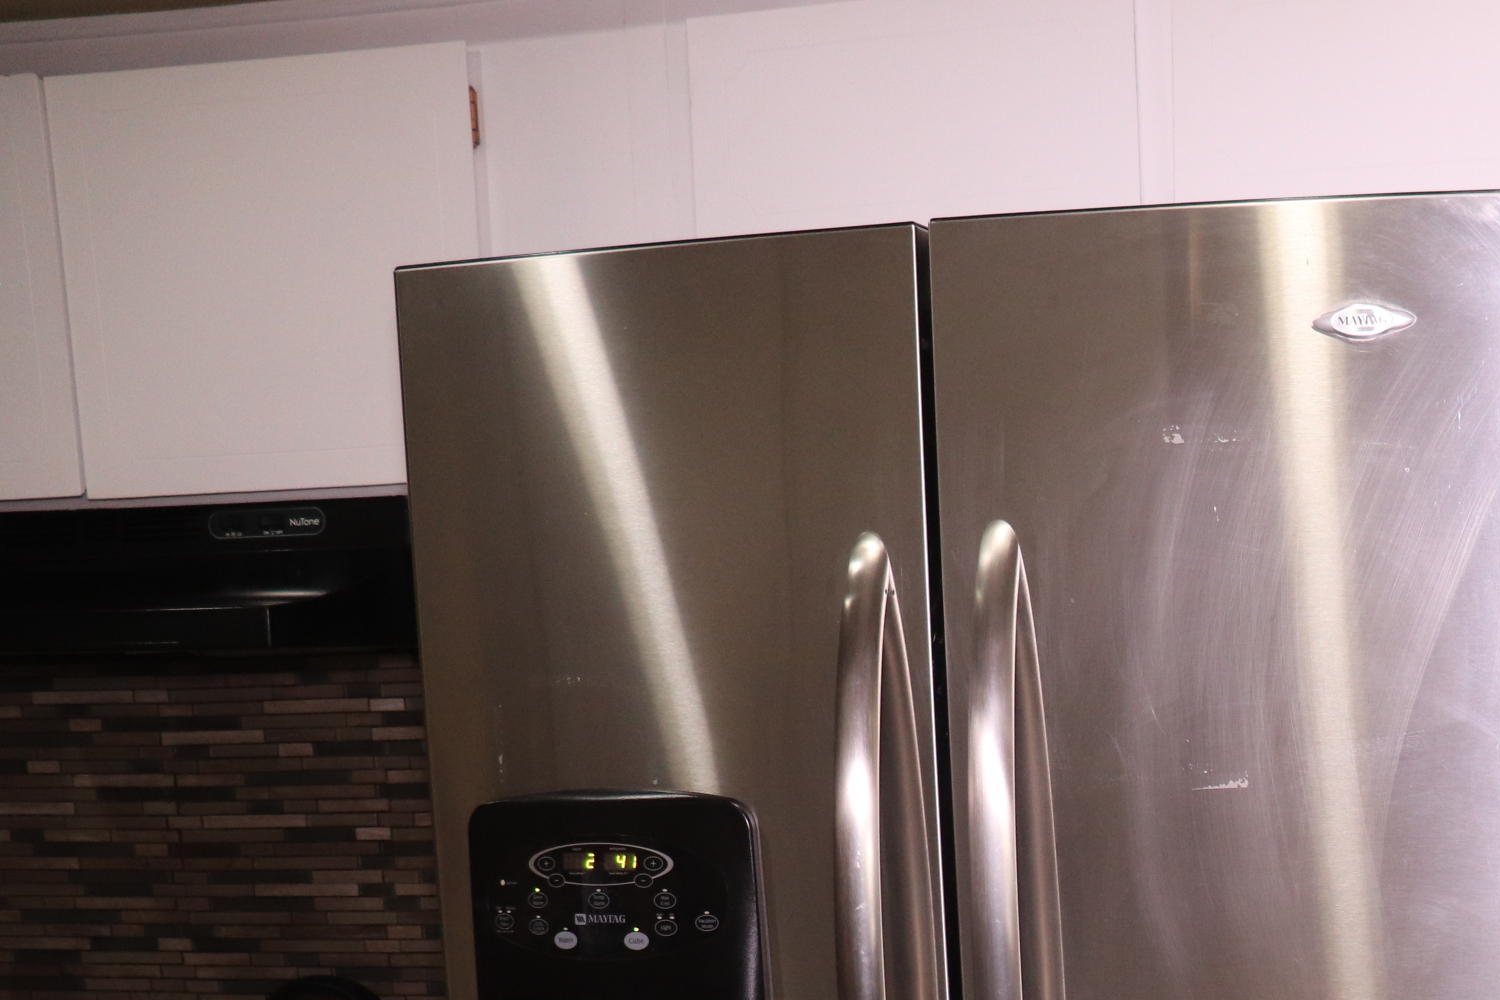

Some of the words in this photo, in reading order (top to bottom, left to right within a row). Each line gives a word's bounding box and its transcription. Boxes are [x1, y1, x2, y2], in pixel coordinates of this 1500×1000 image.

[288, 518, 320, 526] NuTone
[585, 853, 595, 869] 2
[616, 854, 637, 869] 41
[588, 914, 626, 924] MAYTAG
[628, 936, 645, 944] Cube
